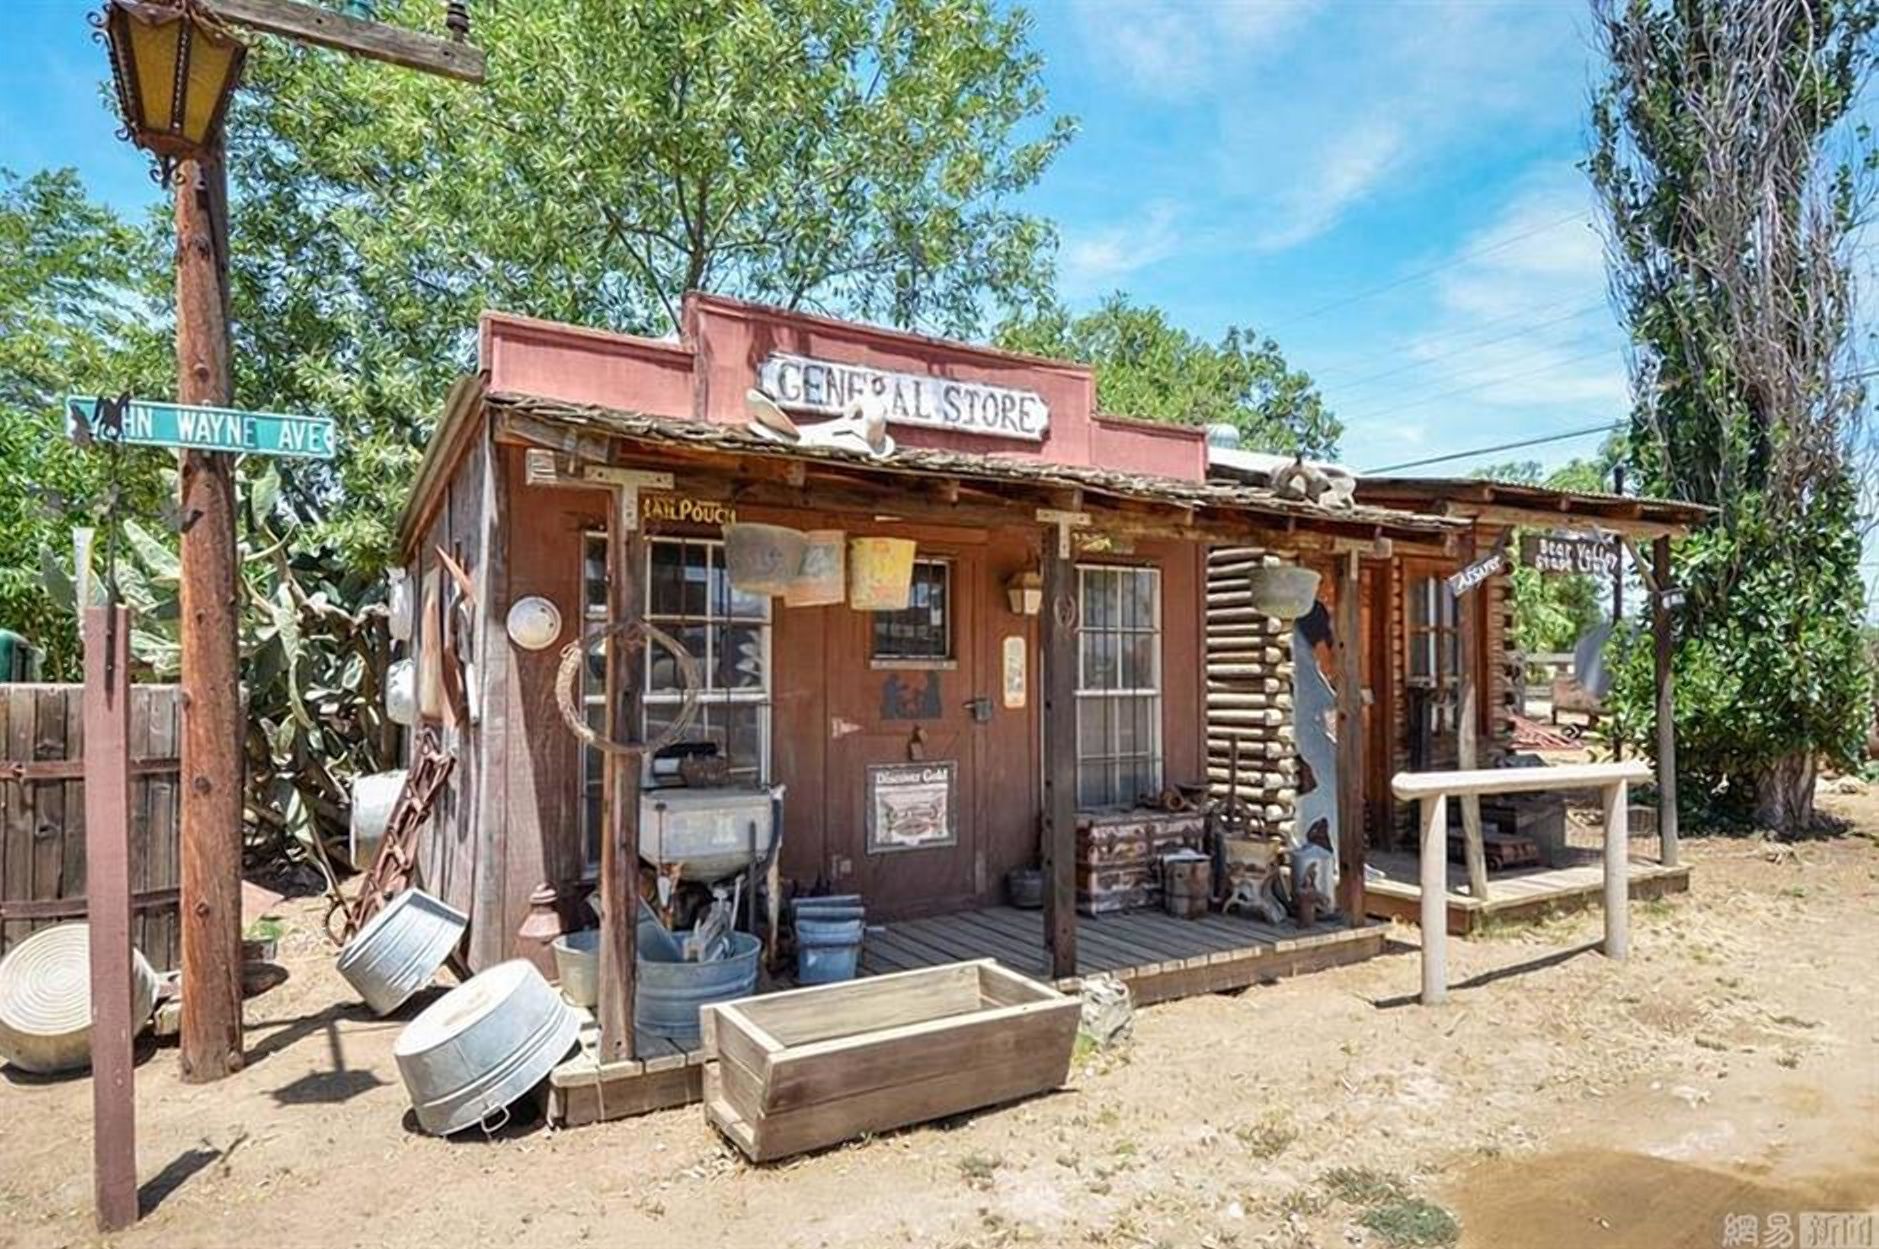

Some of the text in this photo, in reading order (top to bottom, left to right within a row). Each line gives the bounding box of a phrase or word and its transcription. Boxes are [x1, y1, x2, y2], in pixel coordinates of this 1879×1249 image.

[778, 361, 1037, 433] GENEAL STORE
[90, 403, 323, 451] HN WAYNE AVE
[876, 767, 948, 784] Discover Gold
